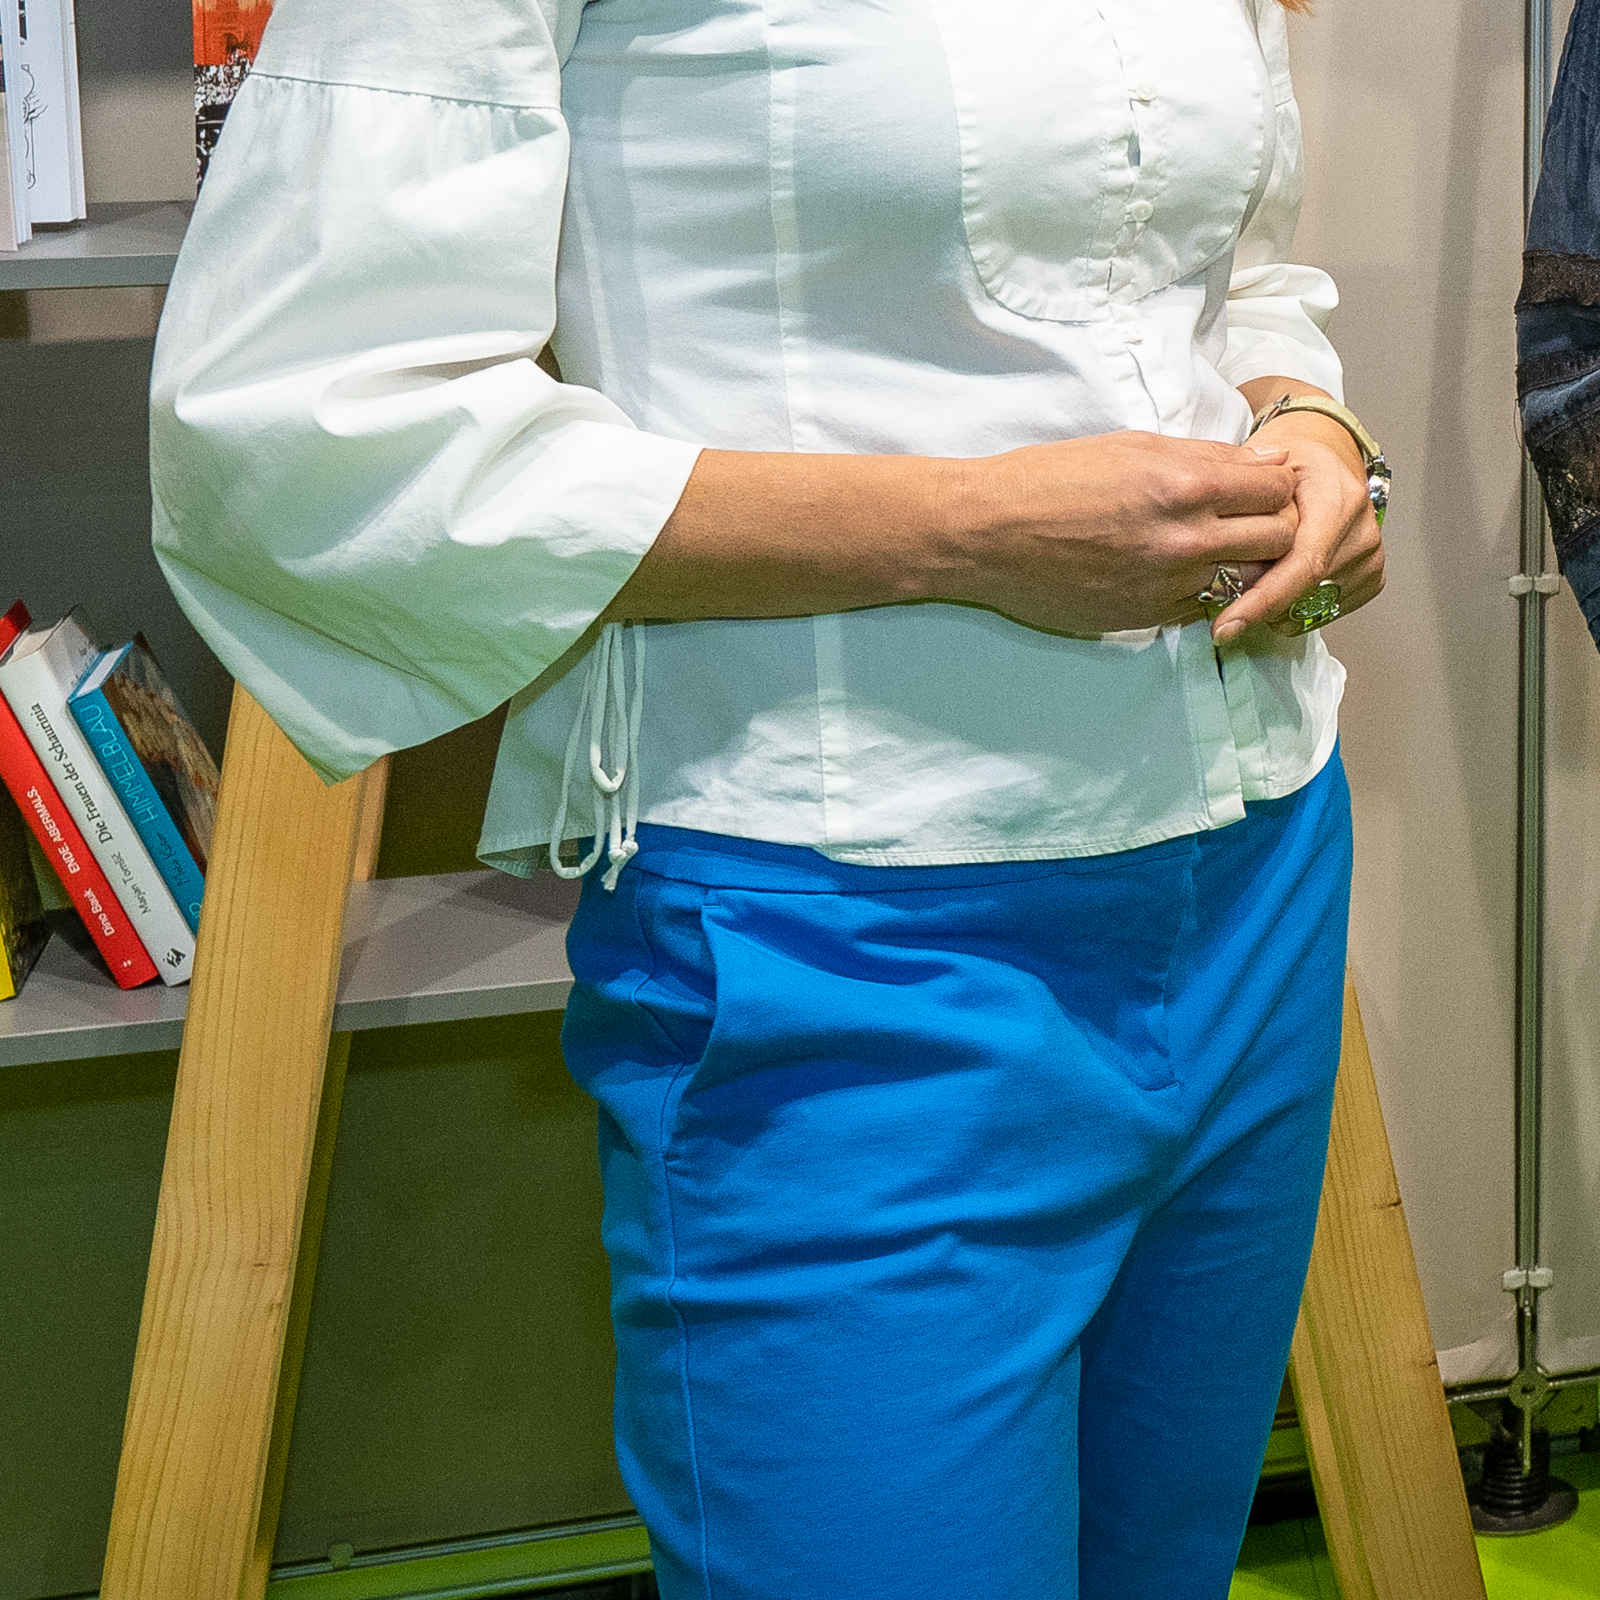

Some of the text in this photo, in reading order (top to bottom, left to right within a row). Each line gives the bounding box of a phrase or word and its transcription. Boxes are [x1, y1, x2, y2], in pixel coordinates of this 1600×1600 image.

[26, 702, 154, 915] Marjan Tomšič Die Frauen der Schaurinia
[78, 699, 158, 826] HIMMELBLAU
[23, 784, 115, 936] Dino Bauk ENDE. ABERMALS.
